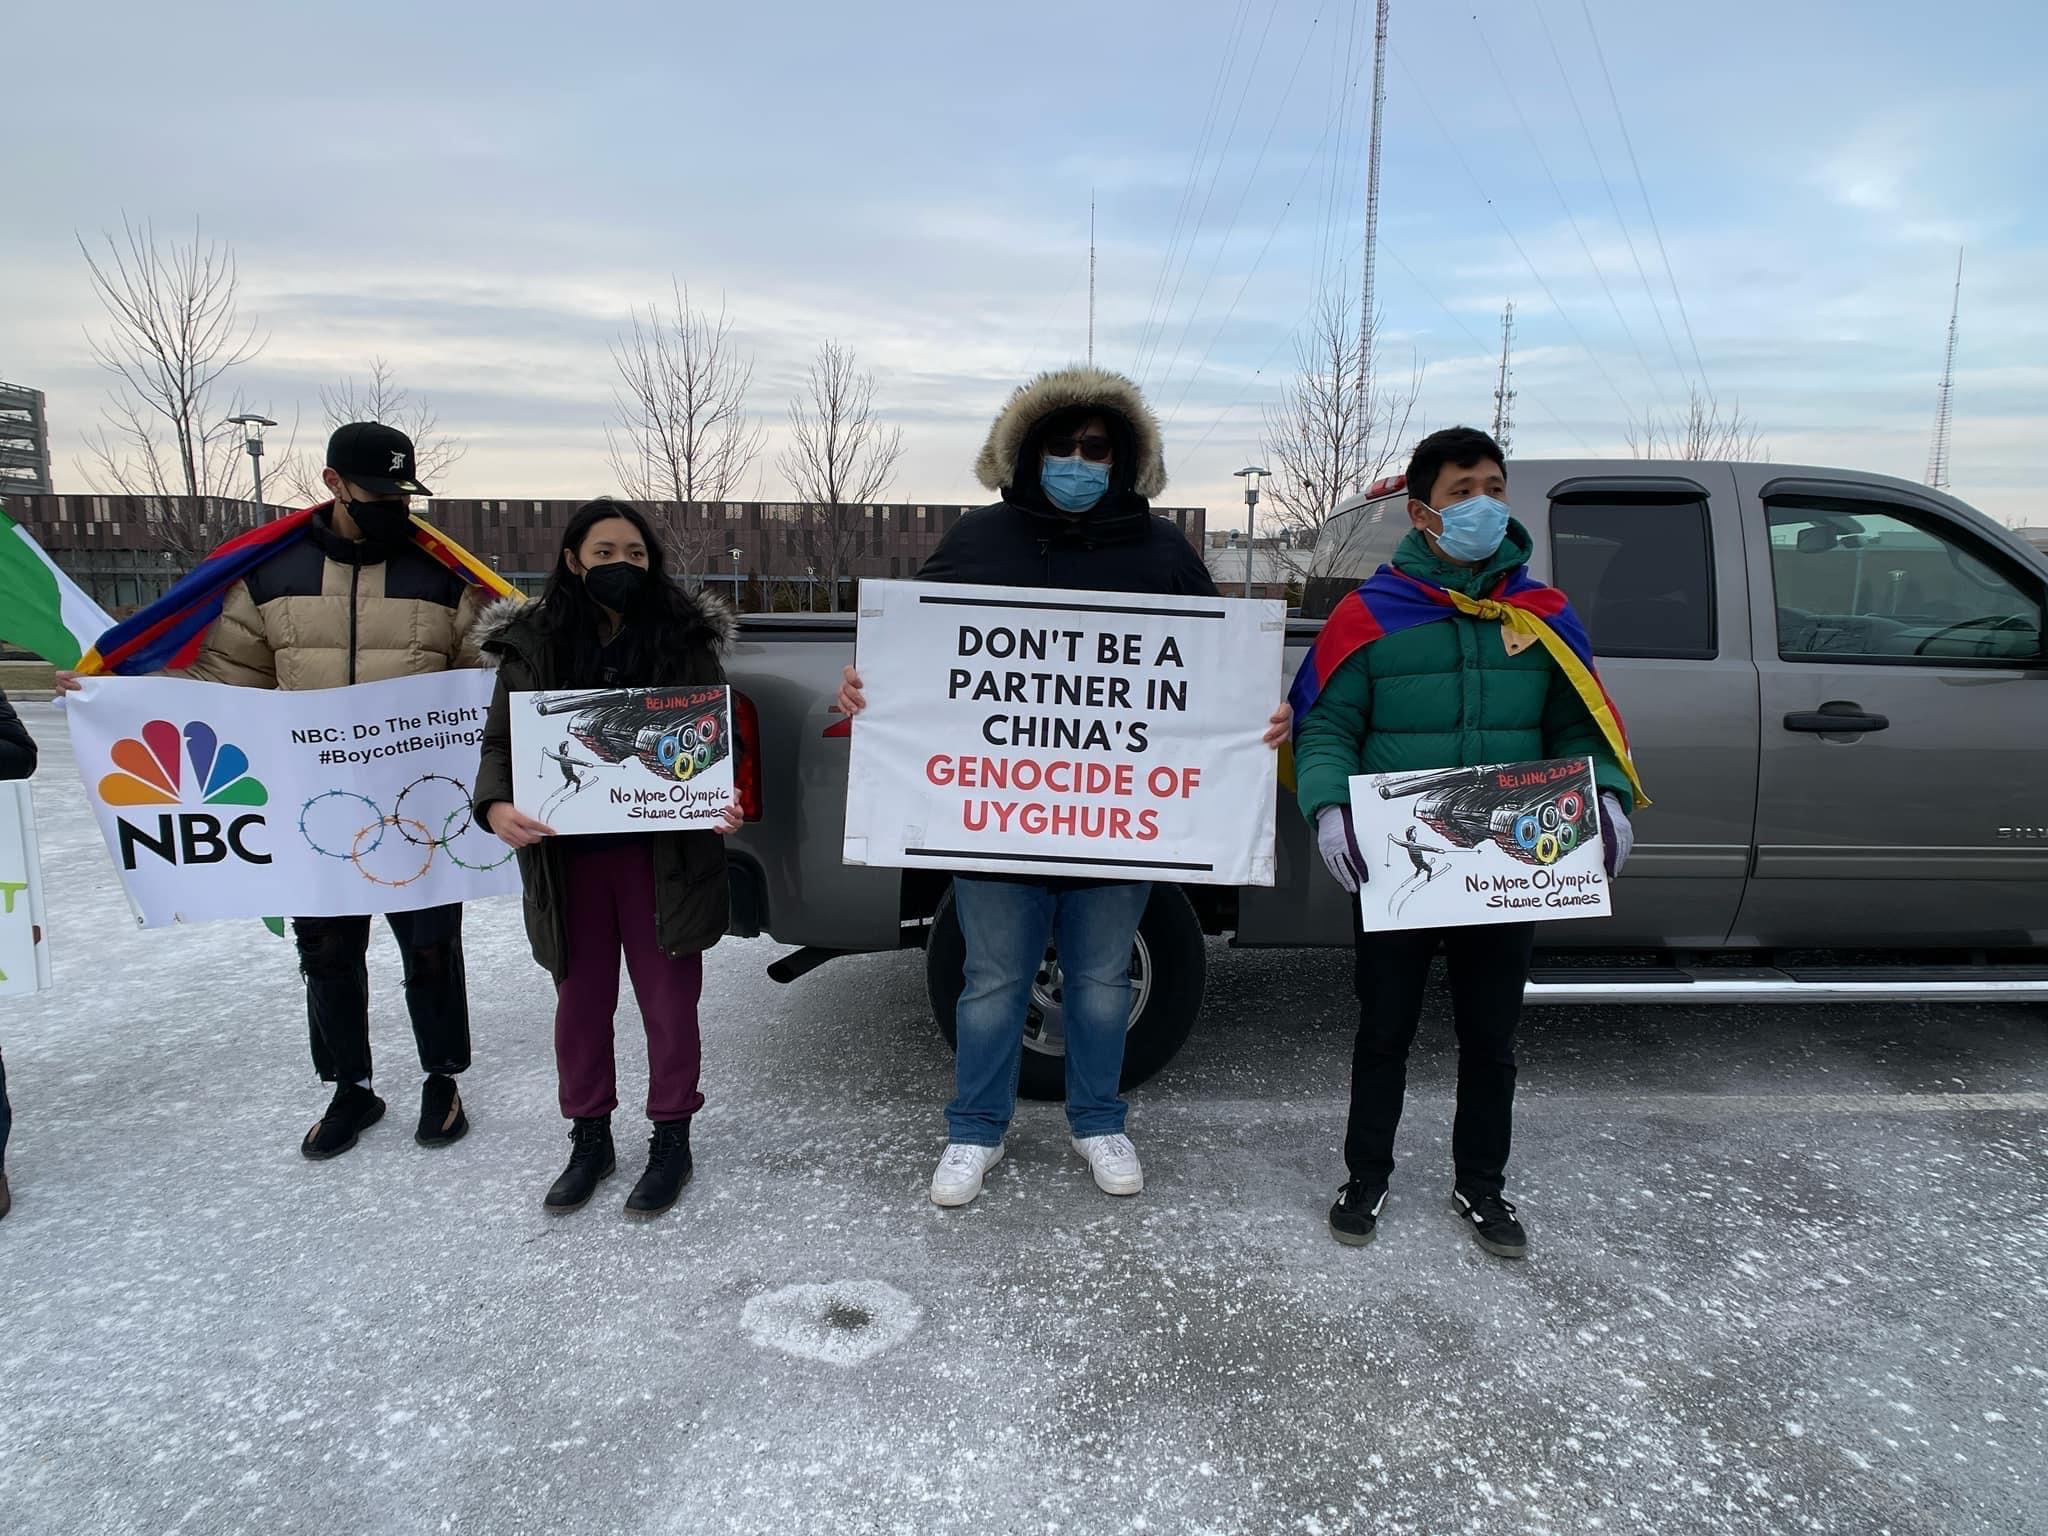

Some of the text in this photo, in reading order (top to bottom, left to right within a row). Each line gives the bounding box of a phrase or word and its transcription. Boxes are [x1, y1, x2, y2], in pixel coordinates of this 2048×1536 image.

[957, 625, 1184, 667] DON'T BE A
[645, 689, 722, 710] BEIJING 2022
[948, 668, 1187, 712] PARTNER IN
[291, 728, 346, 744] NBC:
[352, 724, 380, 739] Do
[385, 717, 421, 733] The
[427, 707, 478, 726] Right
[982, 714, 1149, 753] CHINA'S
[926, 754, 1201, 799] GENOCIDE OF
[1497, 761, 1586, 788] BEIJING 2022
[610, 784, 730, 808] No More Olympic
[627, 805, 727, 820] Shame Games
[962, 800, 1159, 841] UYGHURS
[116, 813, 272, 870] NBC
[1465, 869, 1602, 894] No More Olympic
[1486, 891, 1601, 908] Shame Games
